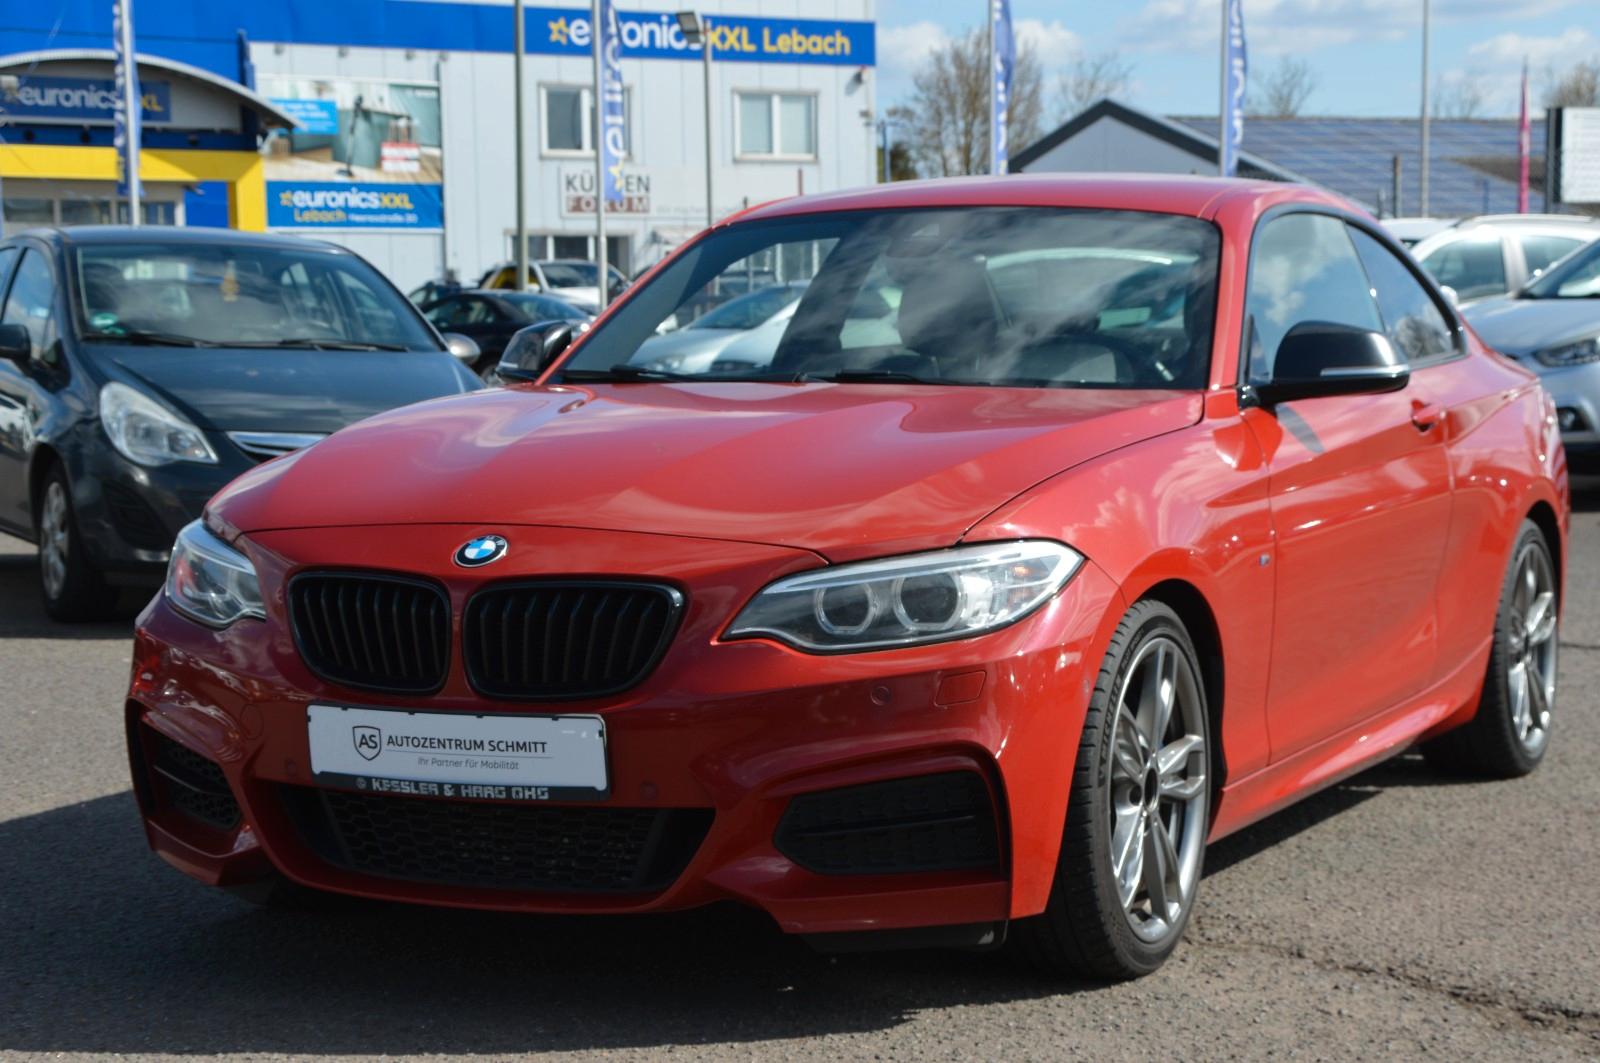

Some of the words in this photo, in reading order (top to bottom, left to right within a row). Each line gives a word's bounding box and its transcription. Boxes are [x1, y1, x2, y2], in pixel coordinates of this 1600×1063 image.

[569, 14, 706, 50] eonic
[709, 26, 757, 52] XXL
[763, 27, 850, 55] Lebach
[565, 169, 651, 193] KÜEN
[292, 188, 380, 209] euronics
[566, 195, 650, 213] FOUM
[359, 733, 377, 749] AS
[386, 735, 485, 751] AUTOZENTRUM
[488, 739, 548, 753] SCHMITT
[418, 757, 429, 766] Ihr
[431, 758, 463, 768] Partner
[464, 759, 479, 769] für
[481, 760, 520, 770] Mobilität
[373, 778, 439, 796] KESSLER
[443, 784, 455, 797] &
[461, 785, 507, 799] HAAG
